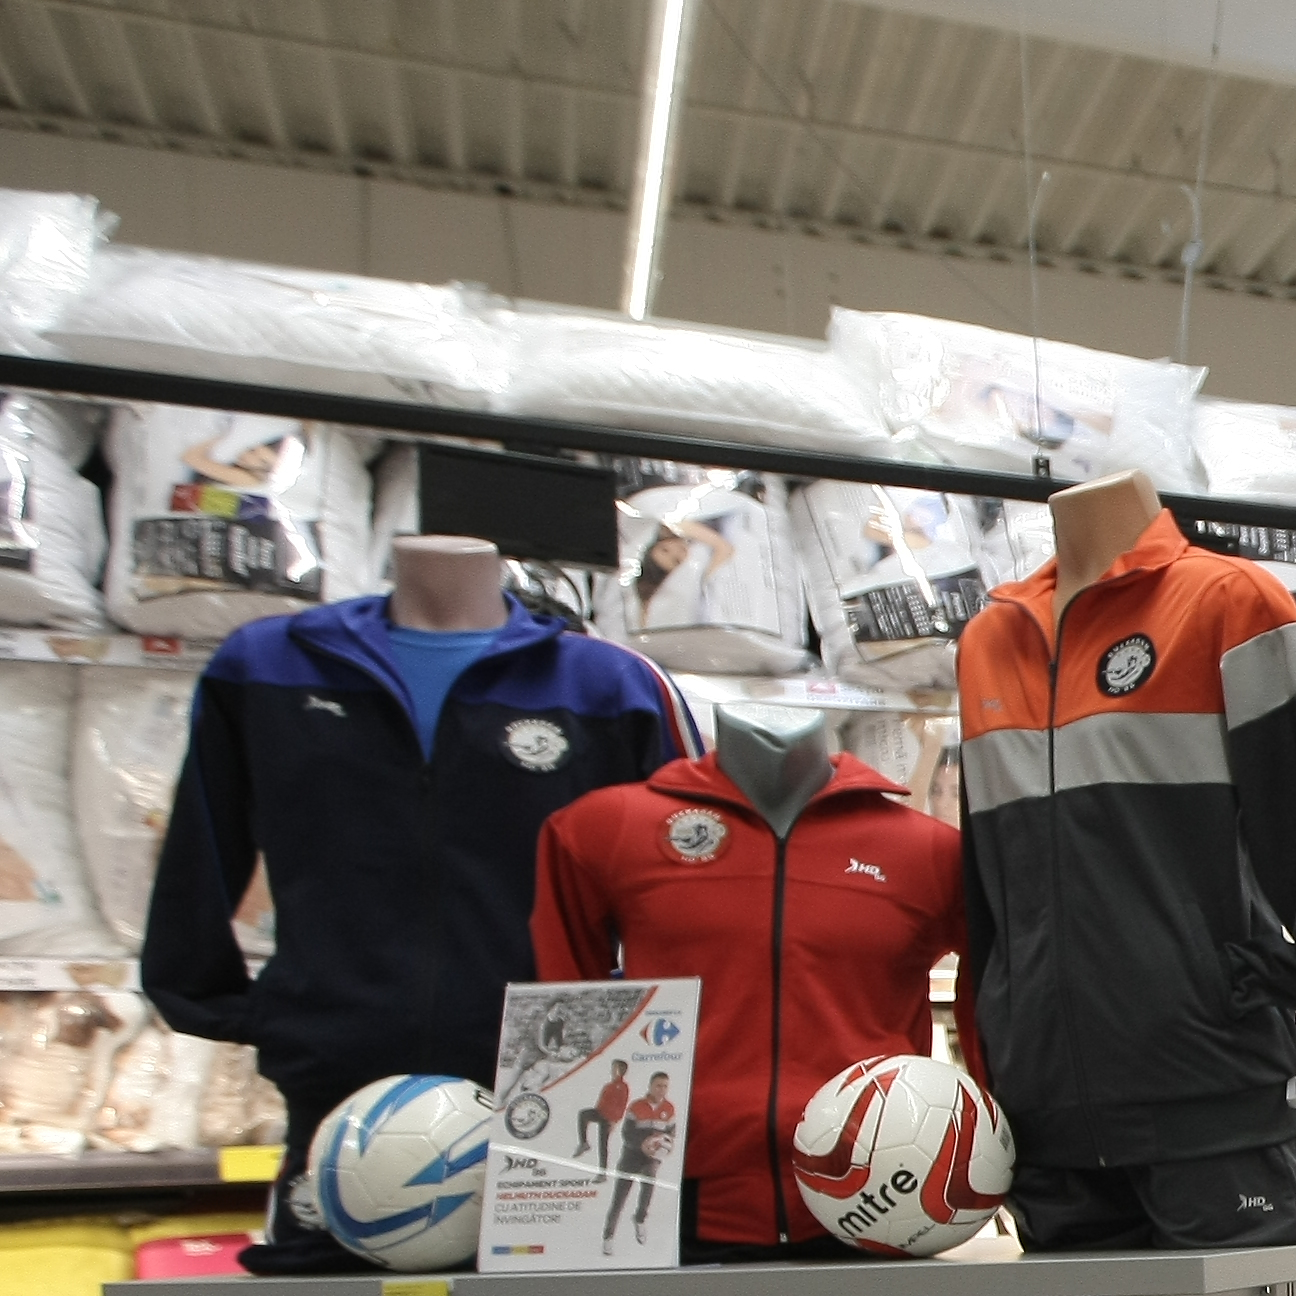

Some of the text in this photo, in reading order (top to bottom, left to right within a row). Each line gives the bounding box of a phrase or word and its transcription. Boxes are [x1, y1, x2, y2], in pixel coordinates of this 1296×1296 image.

[837, 1169, 918, 1237] mitre
[1248, 1196, 1266, 1207] HD
[510, 1202, 564, 1213] ATITUDINE
[567, 1202, 581, 1211] DE
